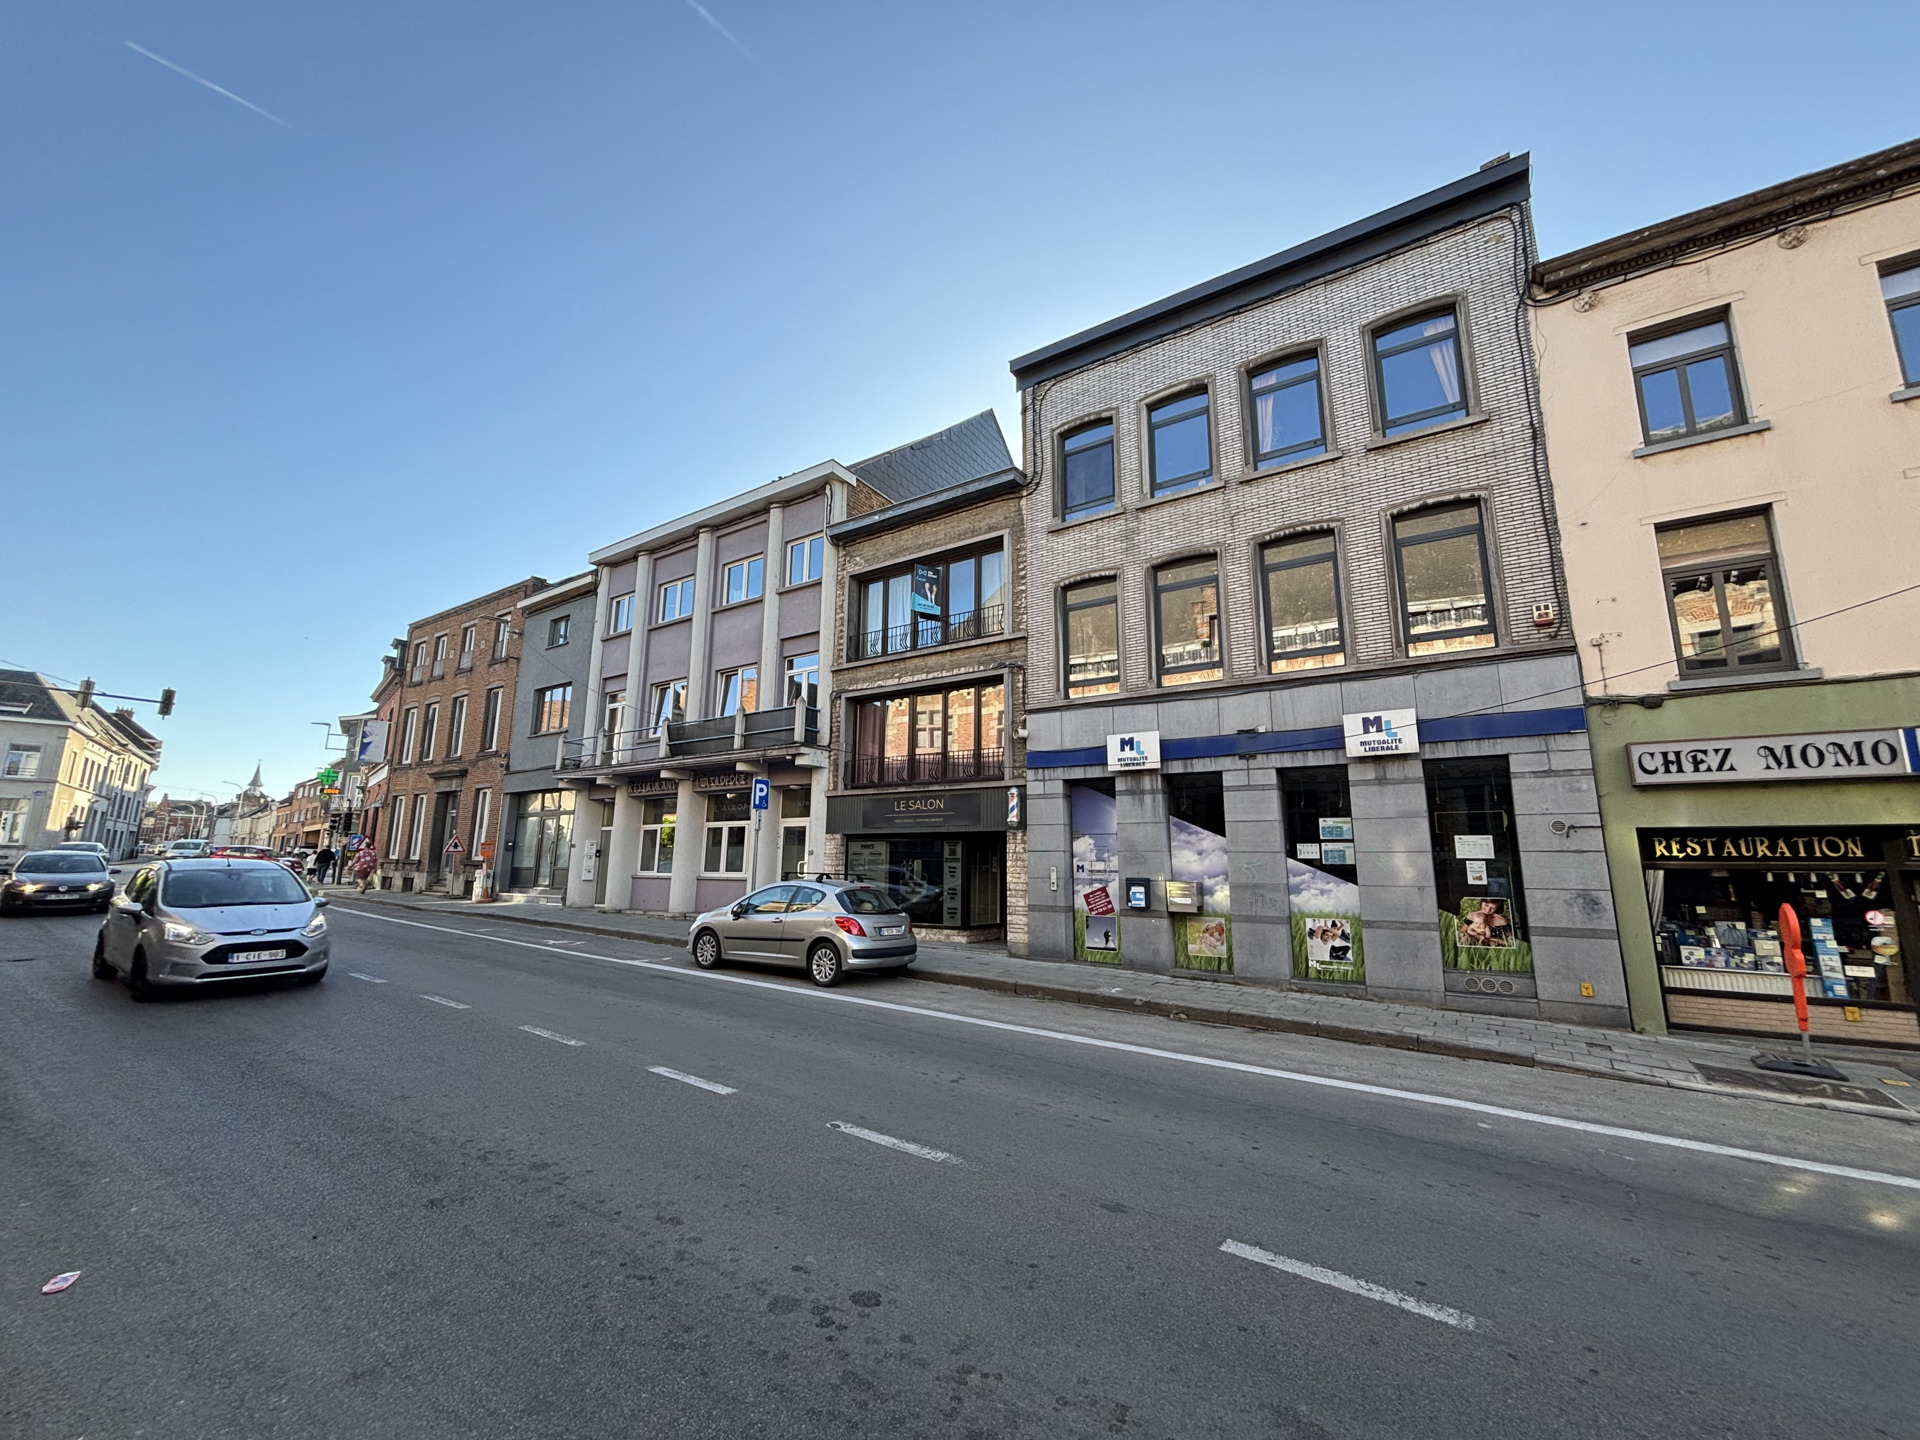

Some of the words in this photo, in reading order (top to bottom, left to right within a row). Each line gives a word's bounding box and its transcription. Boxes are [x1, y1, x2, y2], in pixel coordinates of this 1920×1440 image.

[1362, 715, 1398, 738] ML
[1120, 736, 1145, 756] ML
[1638, 748, 1738, 775] CHEZ
[1757, 739, 1898, 770] MOMO
[755, 783, 768, 805] P
[894, 800, 906, 811] LE
[908, 798, 944, 811] SALON
[1652, 836, 1865, 859] RESTAURATION
